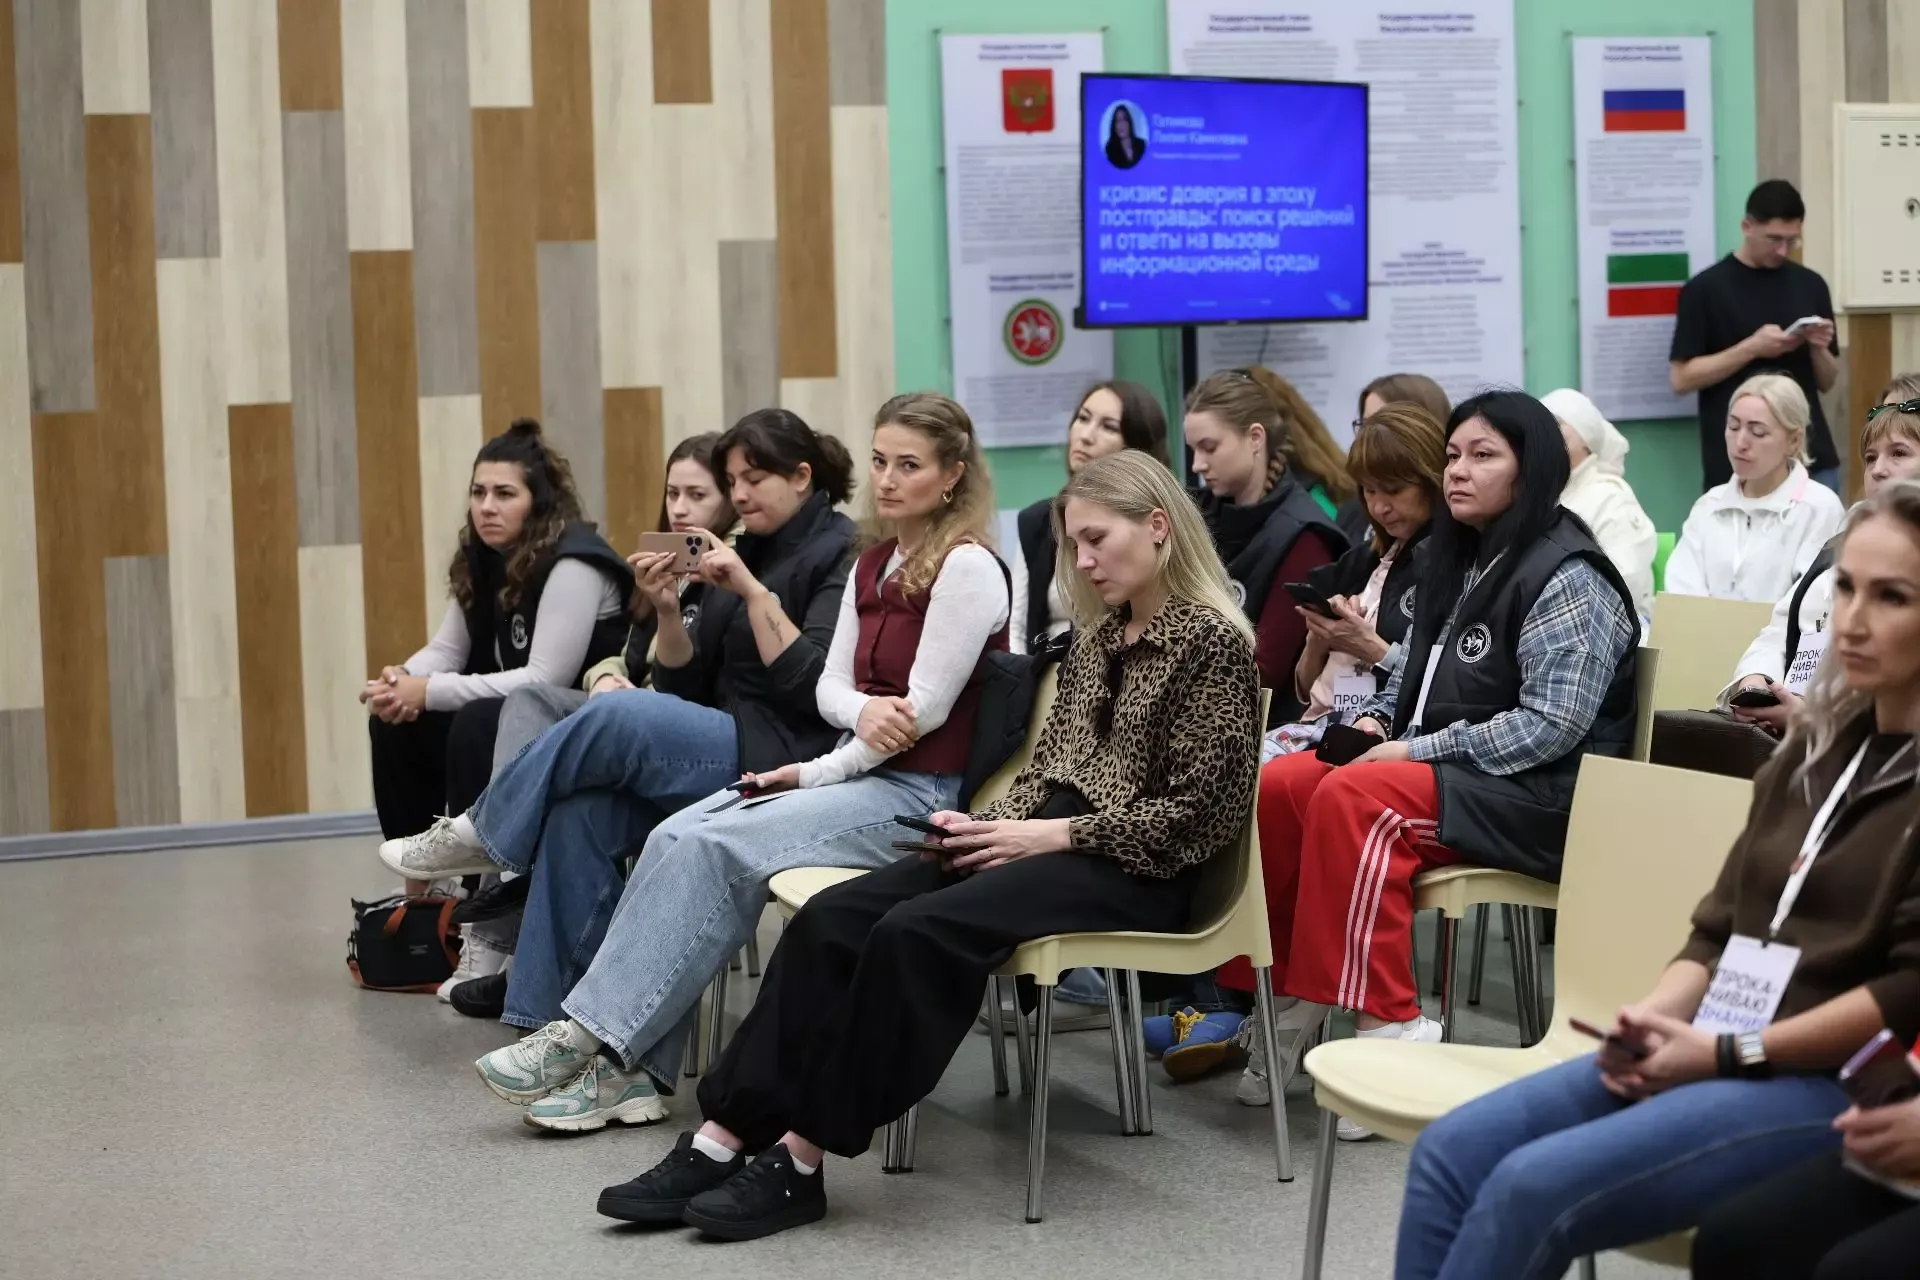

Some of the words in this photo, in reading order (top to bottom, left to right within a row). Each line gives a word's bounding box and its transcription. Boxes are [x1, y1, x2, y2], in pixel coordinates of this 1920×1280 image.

[1100, 186, 1168, 207] кризис
[1171, 187, 1248, 207] доверия
[1251, 187, 1263, 204] в
[1266, 187, 1317, 208] эпоху
[1222, 209, 1274, 226] поиск
[1278, 204, 1355, 230] решений
[1101, 233, 1112, 250] и
[1116, 233, 1182, 250] ответы
[1186, 233, 1209, 249] на
[1212, 232, 1280, 249] вызовы
[1101, 250, 1262, 278] информационной
[1265, 254, 1320, 276] среды
[1795, 649, 1822, 661] ПРОК
[1792, 661, 1817, 672] ЧИВА
[1334, 694, 1368, 705] ПРОК
